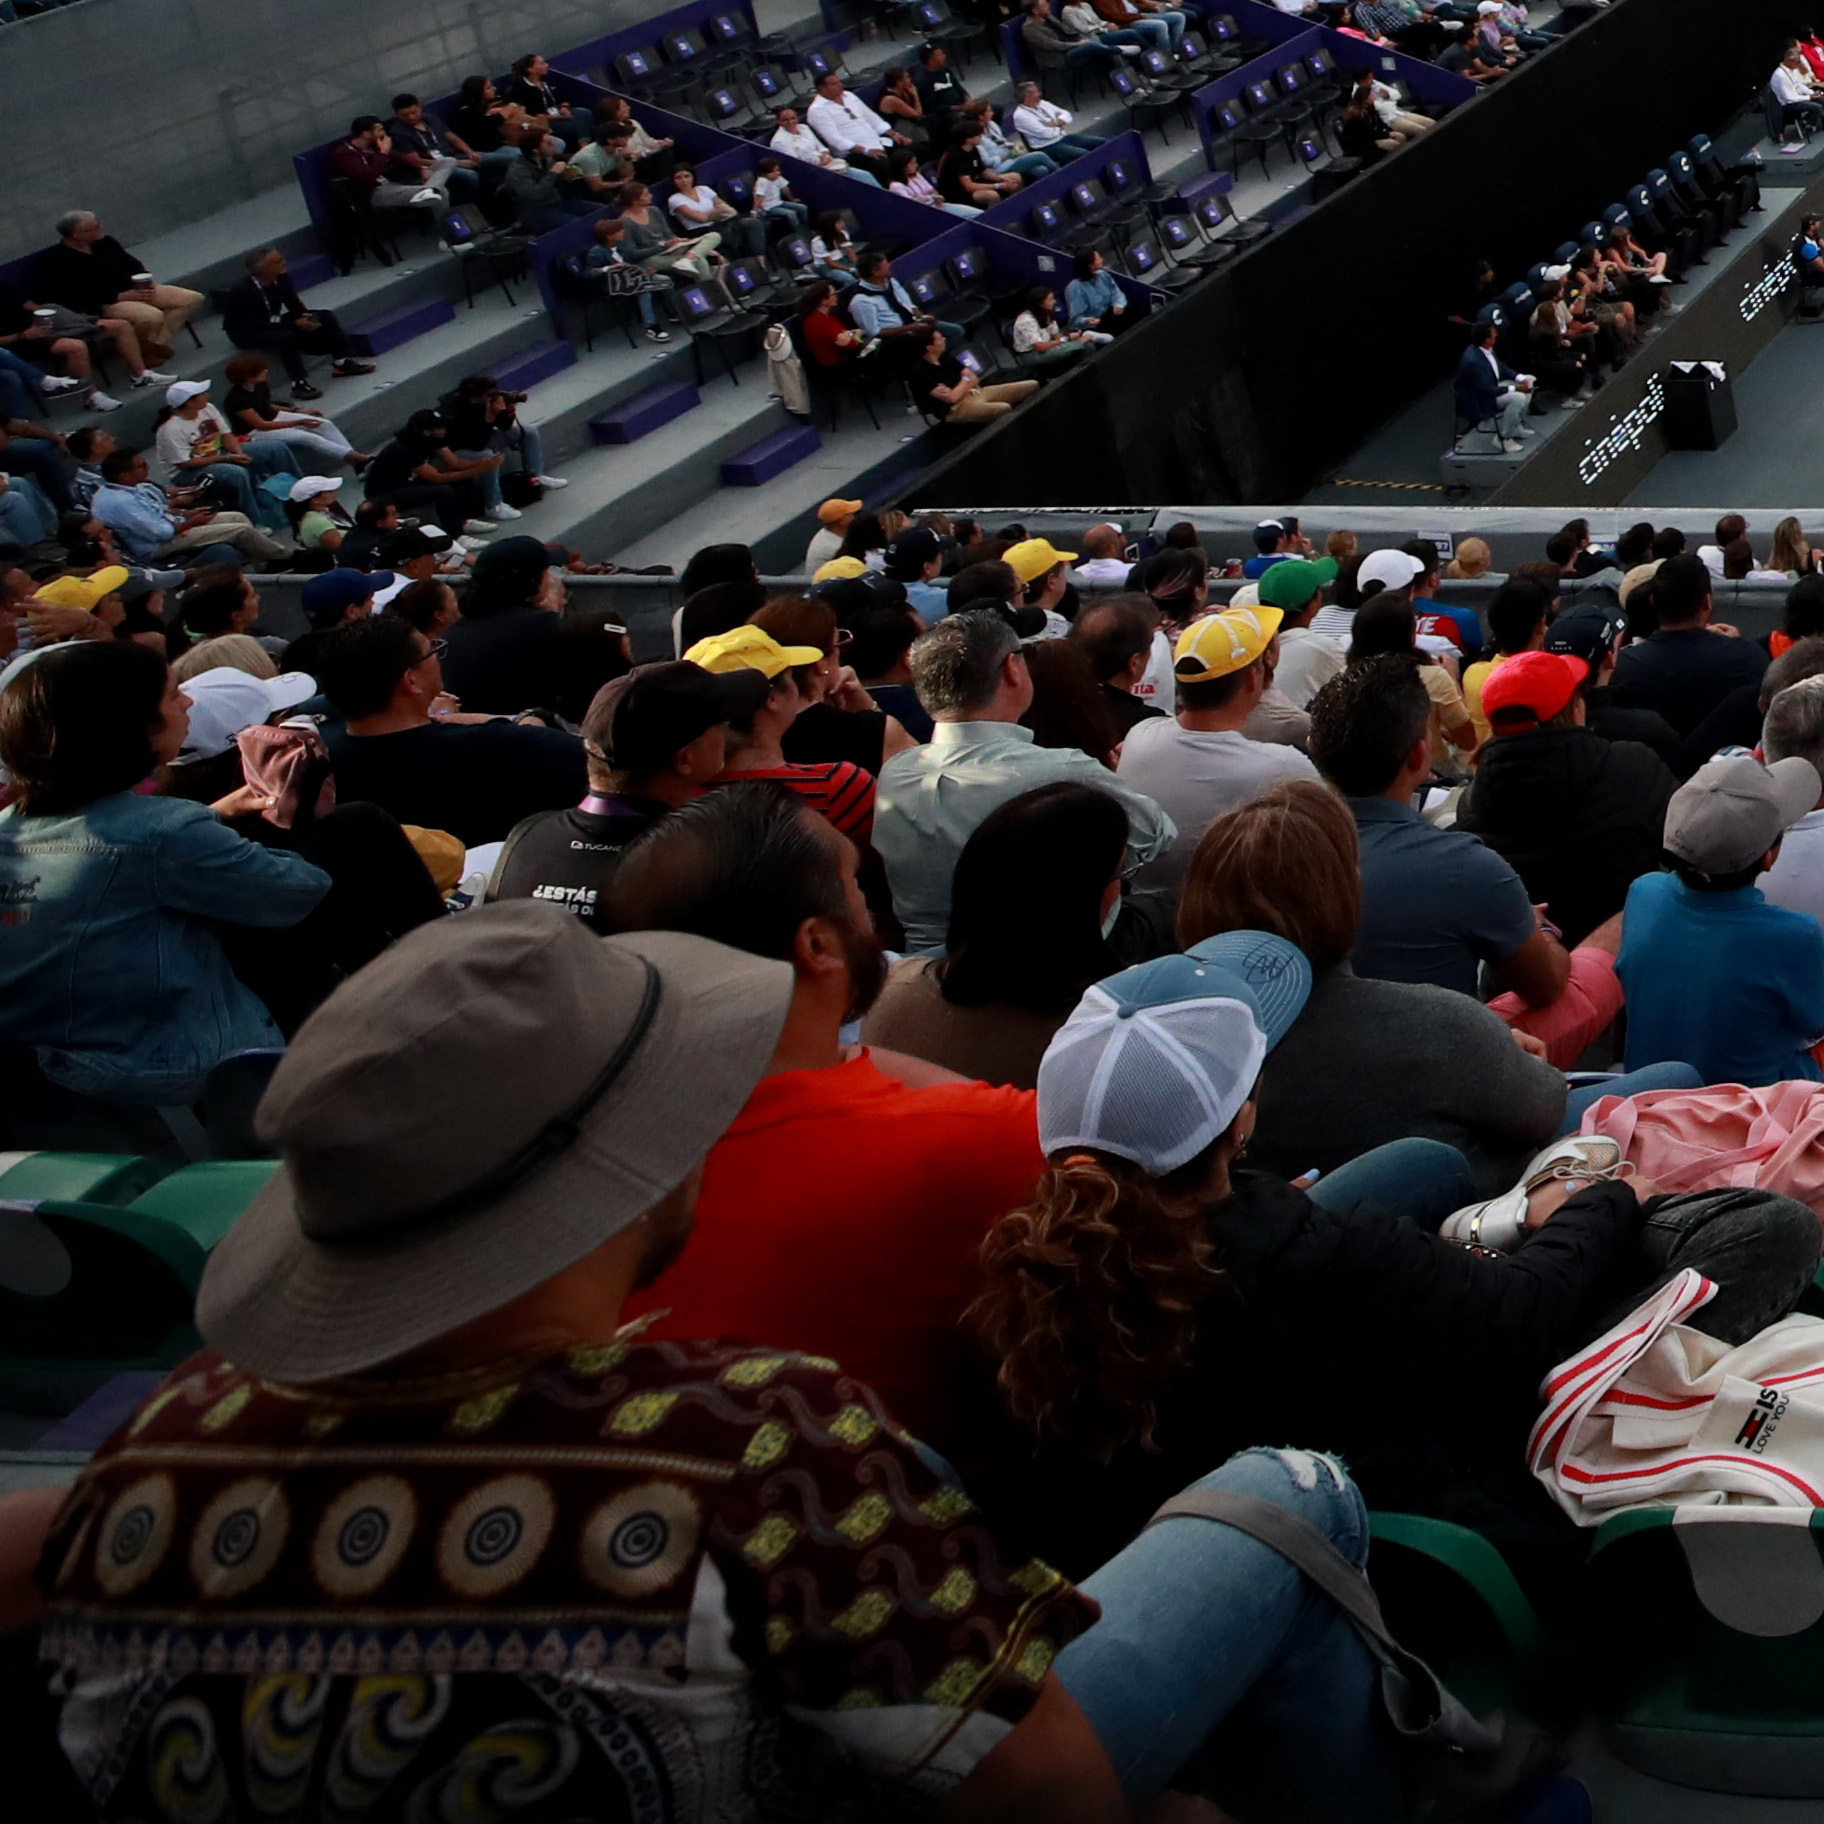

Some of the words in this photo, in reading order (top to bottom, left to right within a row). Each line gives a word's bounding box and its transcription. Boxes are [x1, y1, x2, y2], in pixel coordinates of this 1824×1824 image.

[533, 884, 598, 904] ¿ESTÁS
[1752, 1424, 1777, 1455] LOVE
[1771, 1394, 1790, 1422] YOU
